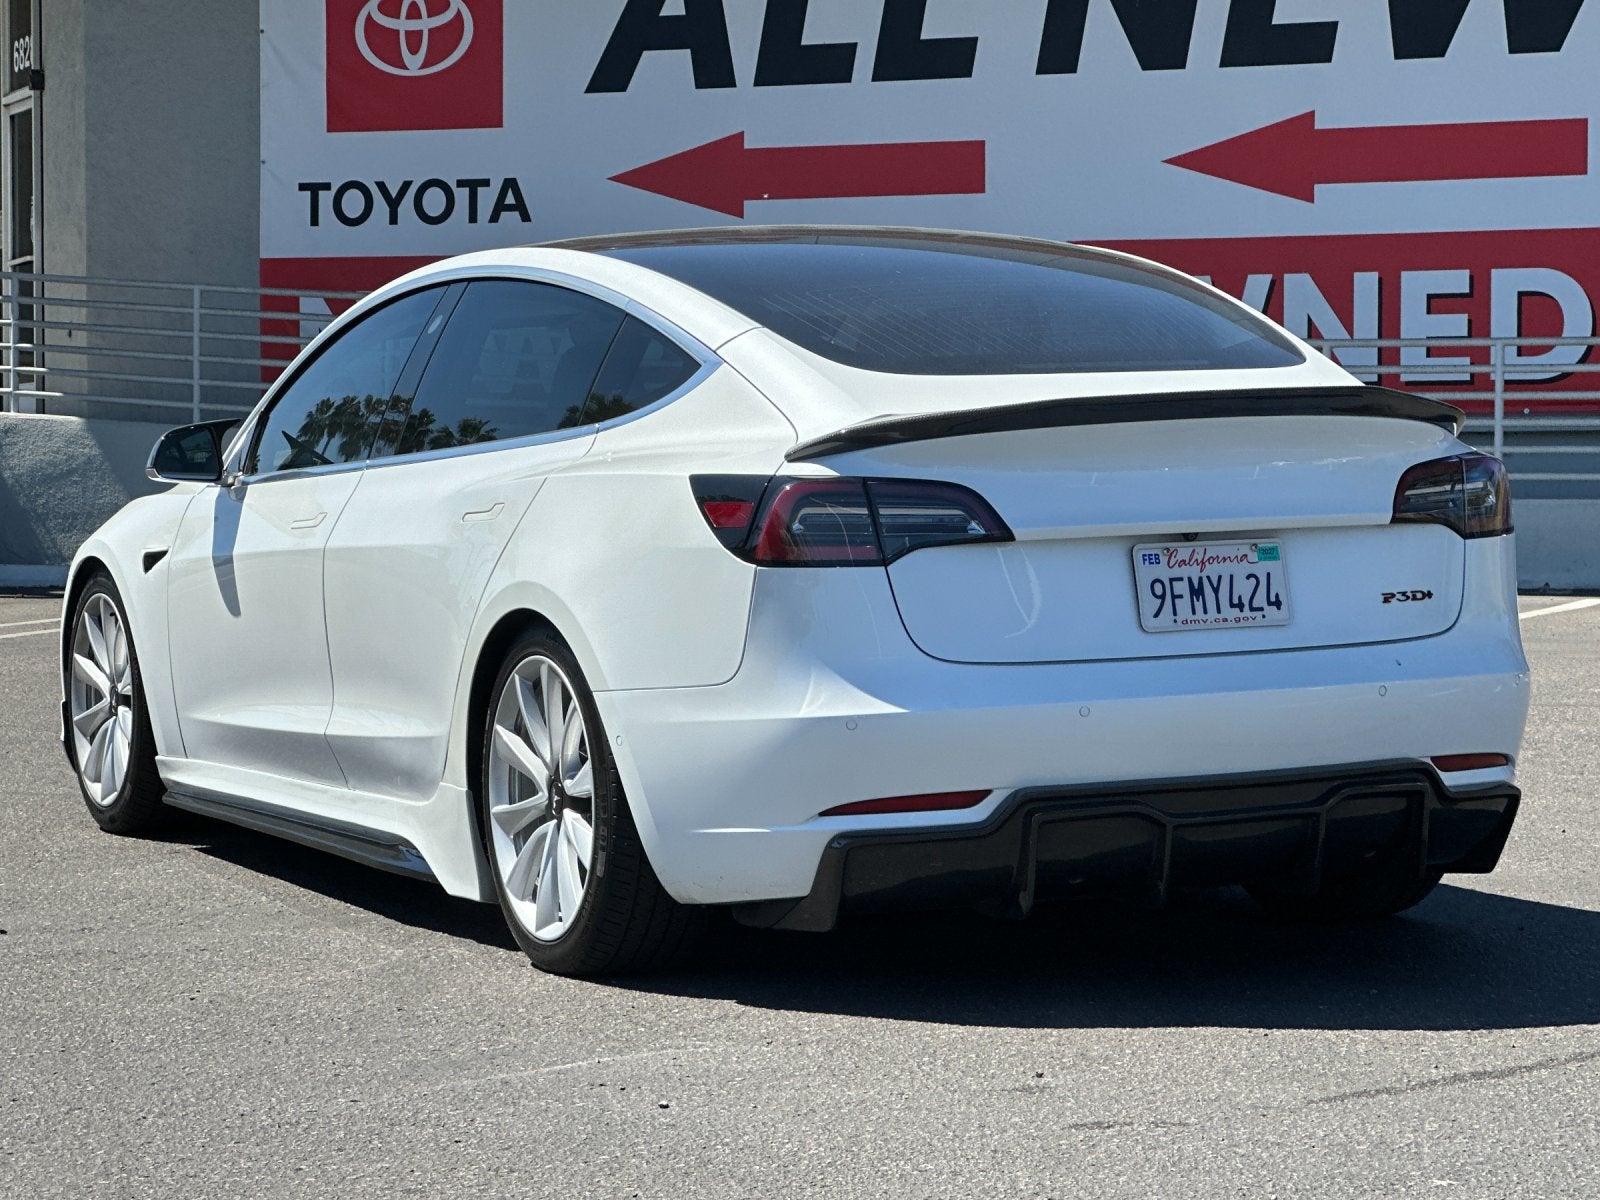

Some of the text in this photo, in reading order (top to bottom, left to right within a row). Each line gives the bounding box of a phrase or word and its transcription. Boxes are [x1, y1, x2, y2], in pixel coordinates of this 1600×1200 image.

[13, 35, 32, 73] 682
[298, 178, 532, 227] TOYOTA
[1198, 267, 1594, 384] NED
[1142, 553, 1161, 566] FEB
[1167, 547, 1258, 573] California
[1150, 572, 1282, 619] 9FMY424
[1381, 589, 1434, 604] P3D+
[1181, 615, 1257, 626] dmv.ca.gov
